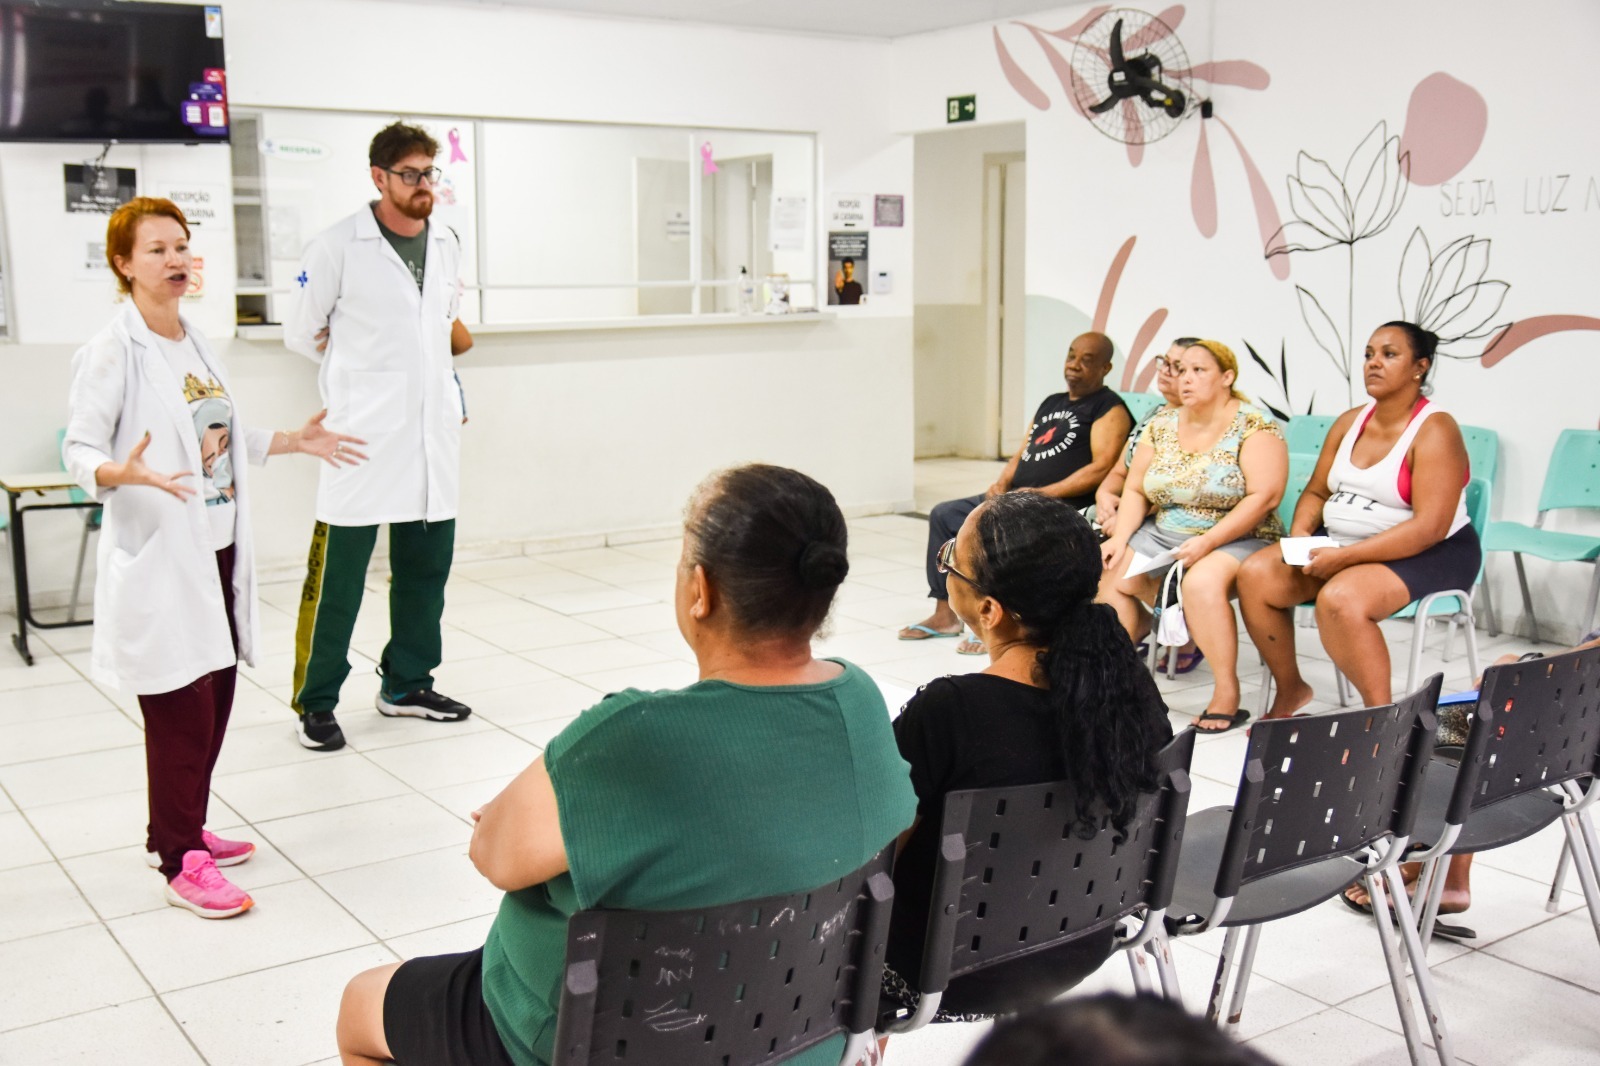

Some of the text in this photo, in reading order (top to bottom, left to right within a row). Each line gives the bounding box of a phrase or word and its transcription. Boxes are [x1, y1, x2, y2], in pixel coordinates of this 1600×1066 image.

[279, 144, 322, 155] RECEPÇÃO
[1440, 179, 1498, 217] SEJA
[1523, 174, 1571, 215] LUZ
[182, 208, 215, 218] ATARINA
